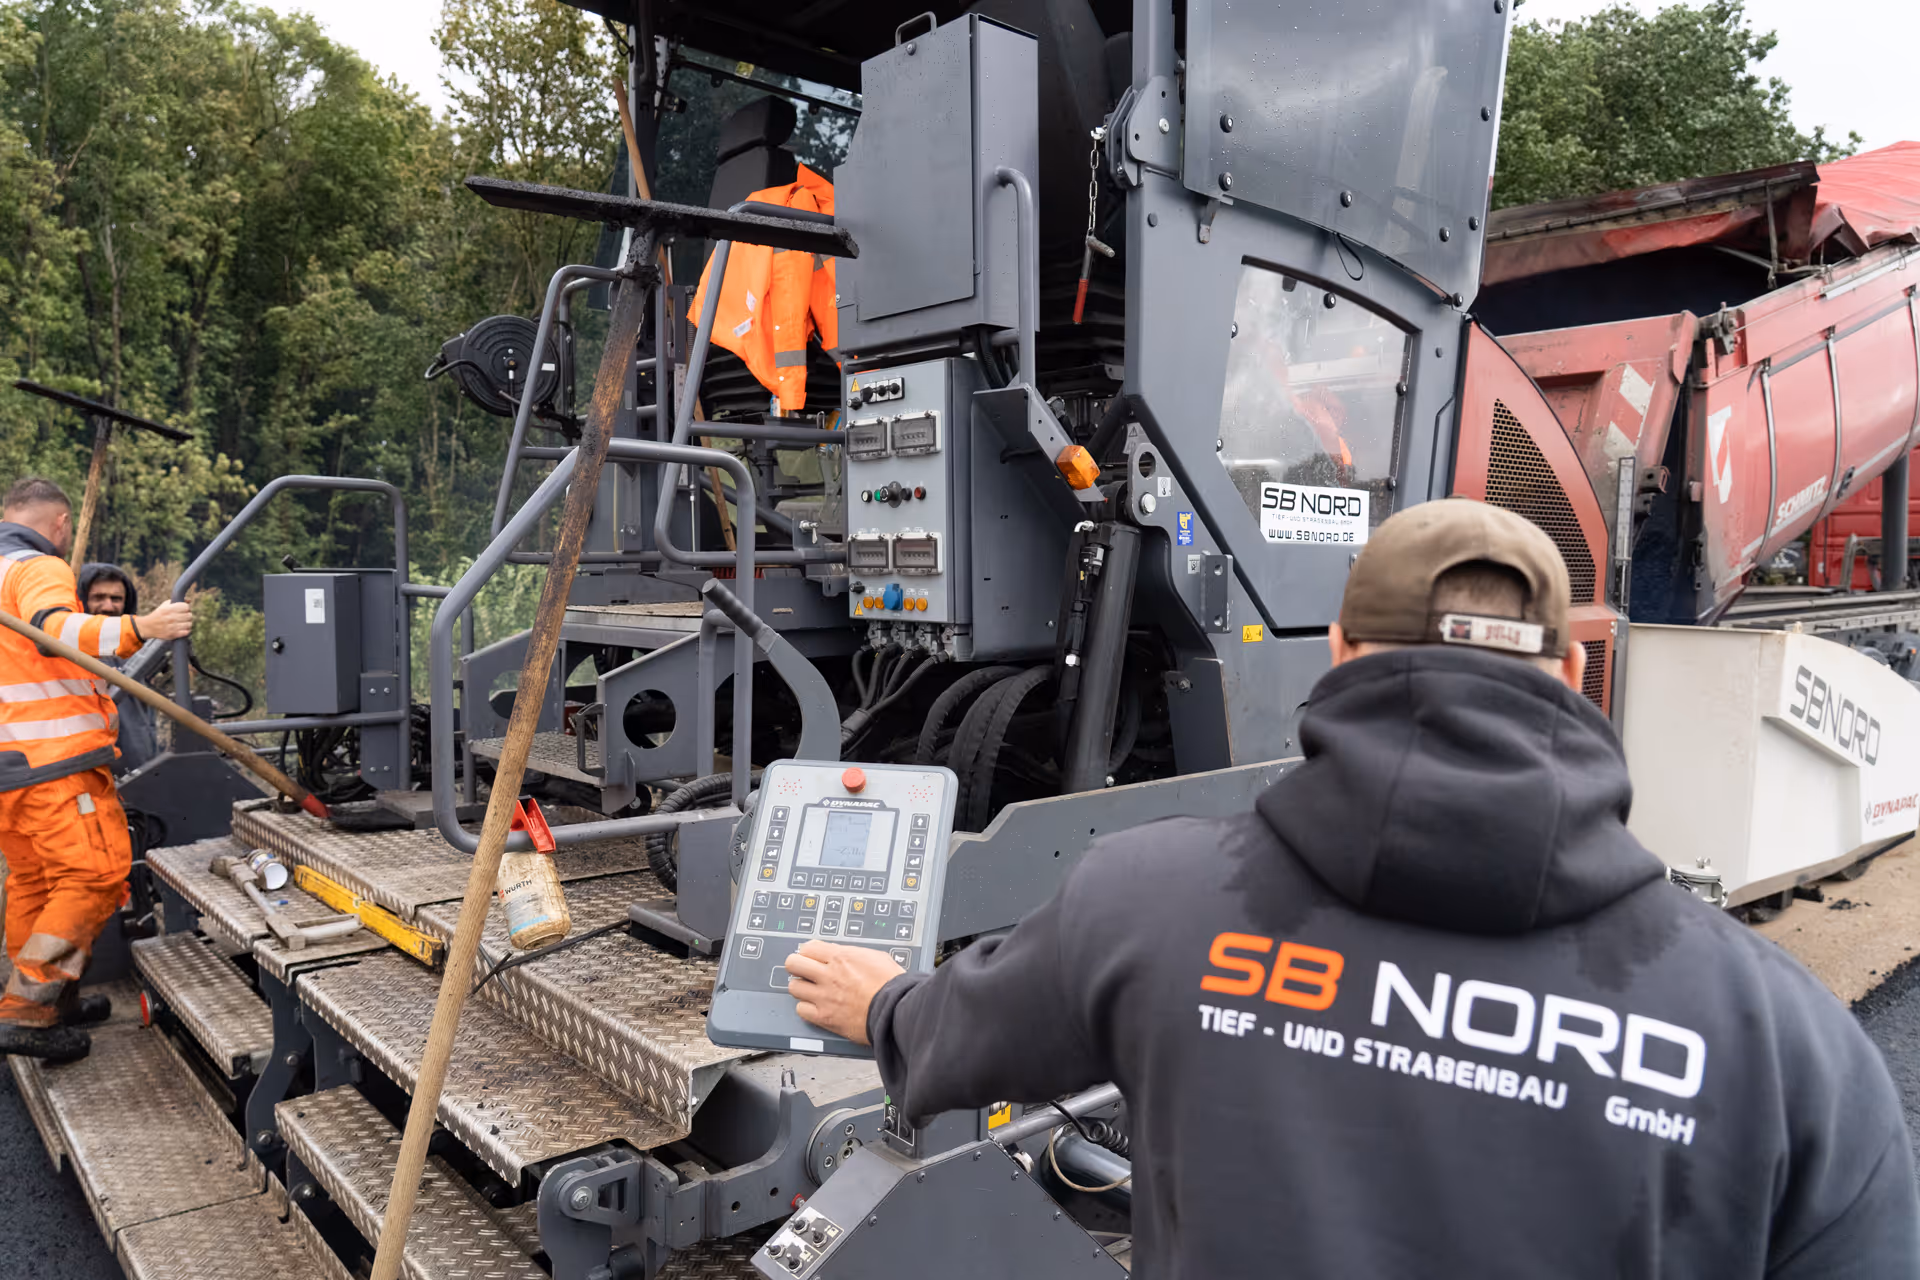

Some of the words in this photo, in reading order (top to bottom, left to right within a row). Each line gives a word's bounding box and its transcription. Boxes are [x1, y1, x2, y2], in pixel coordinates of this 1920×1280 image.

[1262, 487, 1296, 511] SB
[1301, 492, 1361, 517] NORD
[1268, 528, 1355, 543] WWW.SBNORD.DE
[829, 800, 880, 809] DYNAPAC
[1872, 793, 1919, 819] DYNAPAC
[815, 876, 824, 884] F1
[1200, 932, 1345, 1012] SB
[1371, 960, 1708, 1099] NORD
[1198, 1004, 1257, 1037] TIEF
[1283, 1021, 1345, 1058] UND
[1604, 1095, 1697, 1147] GmbH
